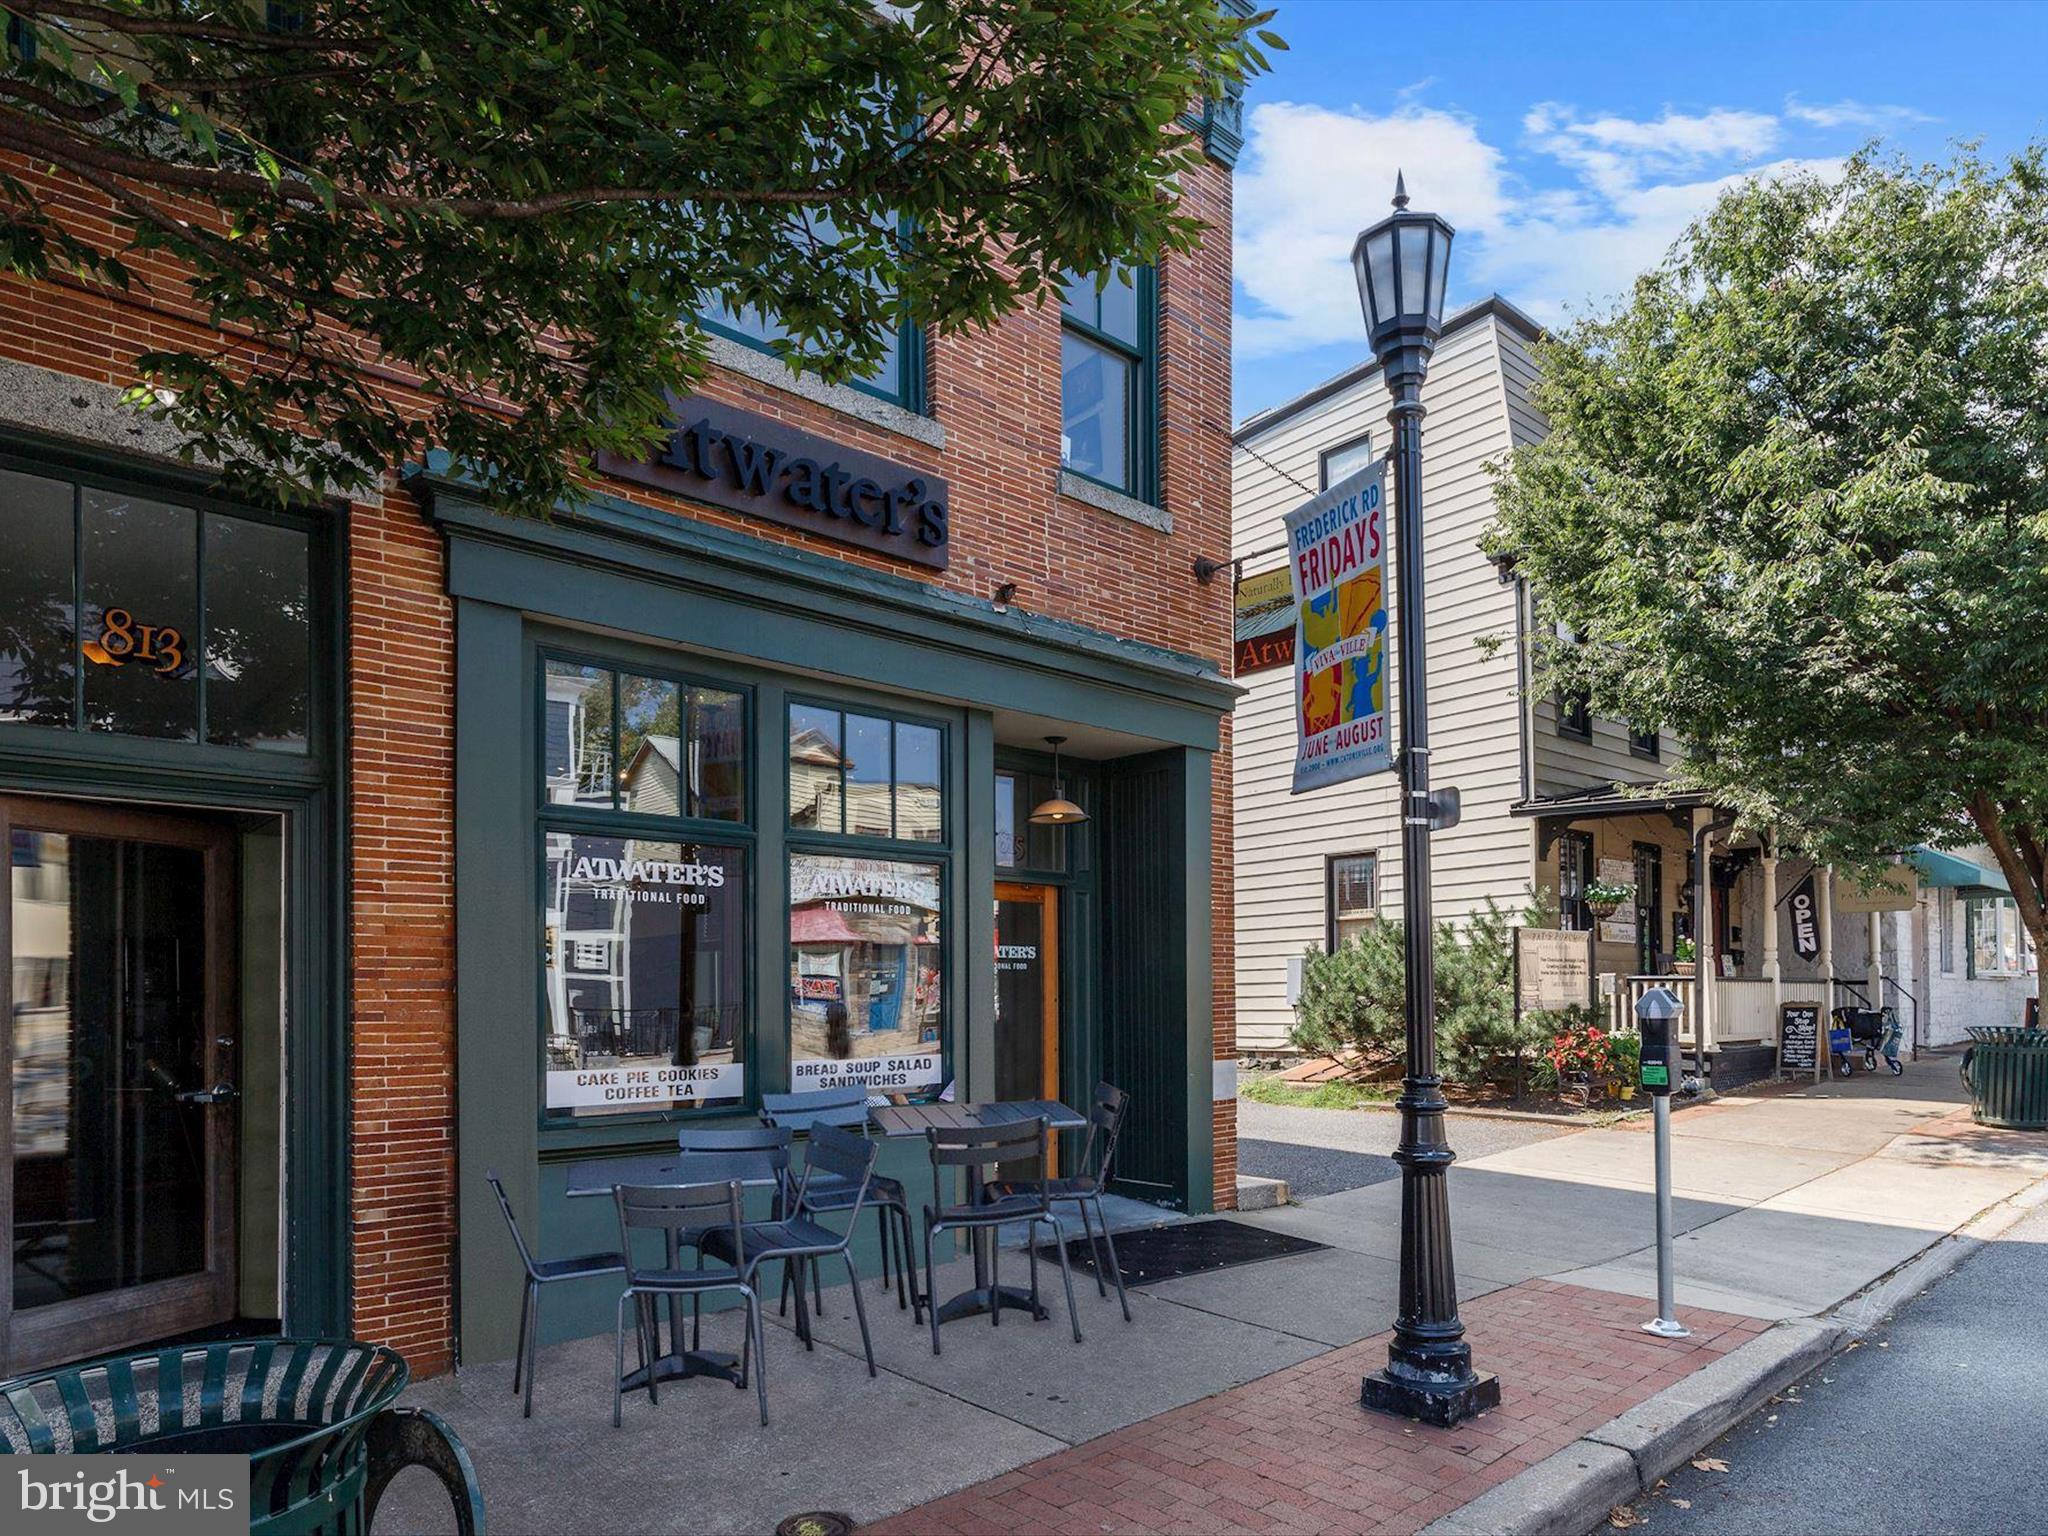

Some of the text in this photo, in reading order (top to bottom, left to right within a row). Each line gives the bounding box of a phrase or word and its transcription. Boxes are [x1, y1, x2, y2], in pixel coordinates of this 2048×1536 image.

[1295, 484, 1379, 551] FREDERICK RD
[1298, 511, 1381, 597] FRIDAYS
[100, 607, 183, 673] 813
[1237, 639, 1295, 670] Atw
[1314, 649, 1336, 670] VIVA
[1340, 638, 1367, 657] VILLE
[1302, 716, 1384, 760] JUNE AUGUST
[572, 856, 725, 888] ATWATER'S
[811, 872, 928, 900] ATWATER'S
[594, 888, 705, 905] TRADITIONAL FOOD
[825, 901, 912, 915] TRADITIONAL FOOD
[1793, 894, 1817, 953] OPEN
[577, 1067, 720, 1087] CAKE PIE COOKIES
[796, 1058, 933, 1077] BREAD SOUP SALAD
[819, 1072, 907, 1089] SANDWICHES
[605, 1084, 694, 1101] COFFEE TEA
